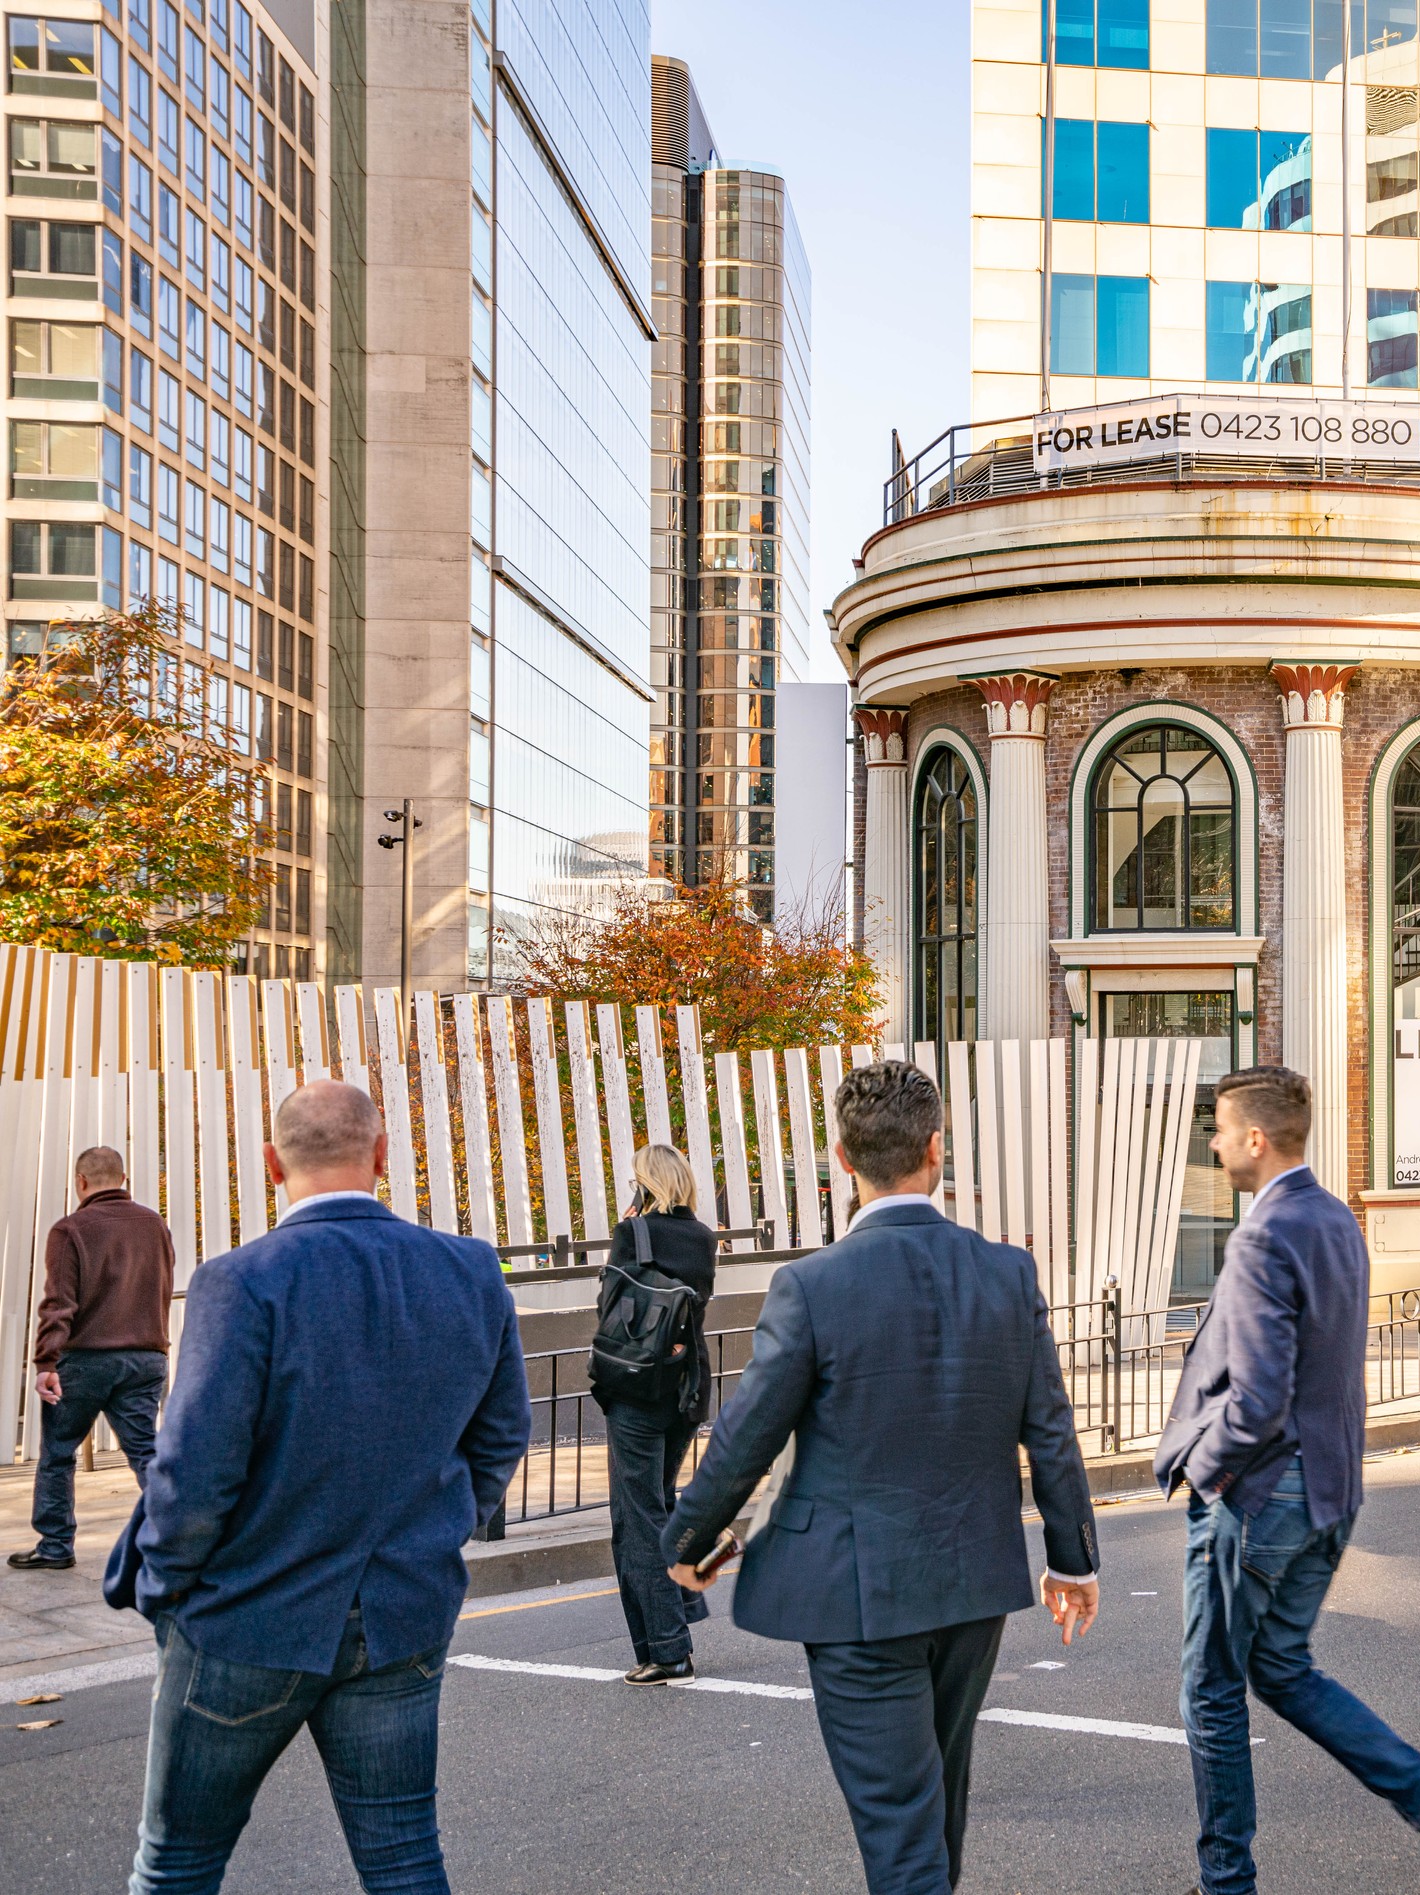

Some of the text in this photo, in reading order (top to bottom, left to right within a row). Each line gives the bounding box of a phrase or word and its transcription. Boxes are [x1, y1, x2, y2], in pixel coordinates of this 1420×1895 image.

[1037, 412, 1412, 456] FOR LEASE 0423 108 880
